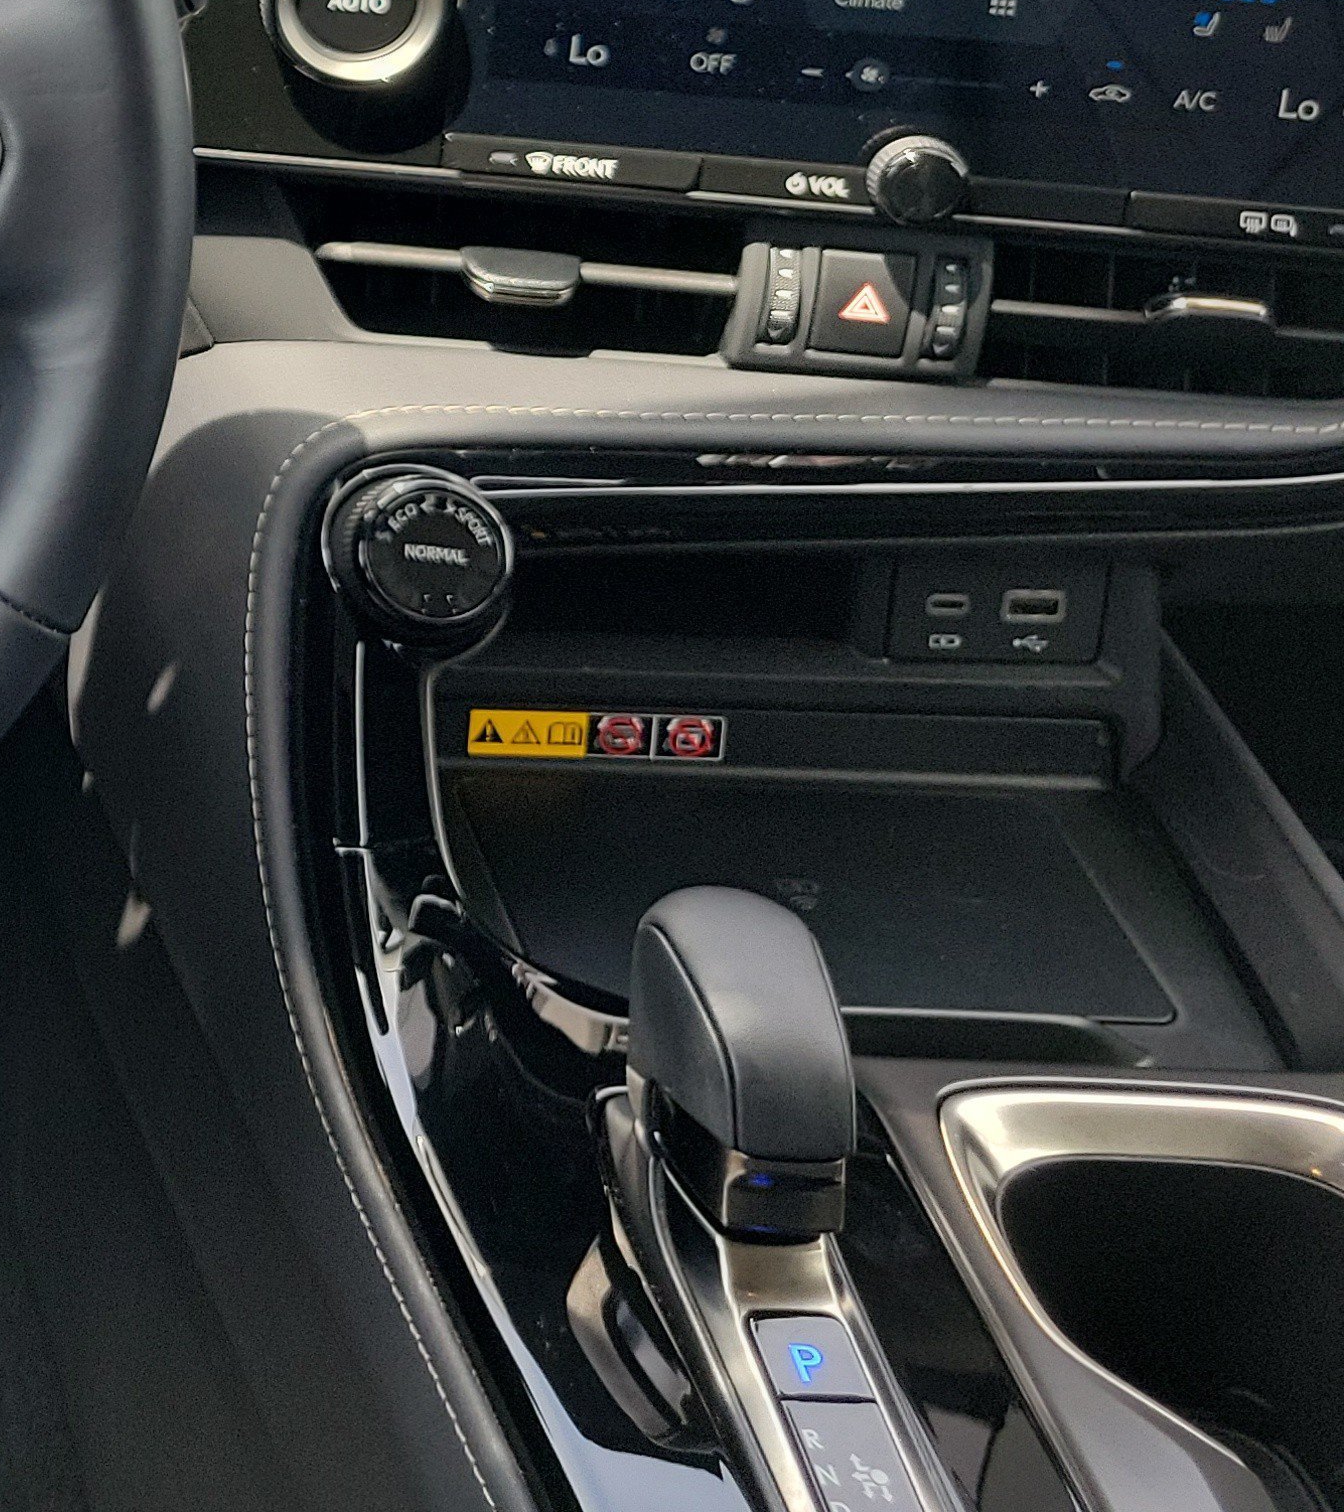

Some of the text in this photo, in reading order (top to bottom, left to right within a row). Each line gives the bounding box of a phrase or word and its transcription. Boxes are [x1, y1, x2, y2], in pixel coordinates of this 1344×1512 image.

[569, 34, 611, 67] Lo
[690, 51, 737, 76] OFF
[1173, 89, 1218, 112] A/C
[1278, 88, 1320, 121] Lo
[551, 155, 619, 180] FRONT
[808, 174, 851, 199] VOL
[388, 502, 419, 534] ECO
[455, 507, 493, 546] SPORT
[404, 543, 470, 566] NORMAL
[788, 1343, 824, 1382] P
[802, 1429, 824, 1450] R
[815, 1464, 842, 1487] N
